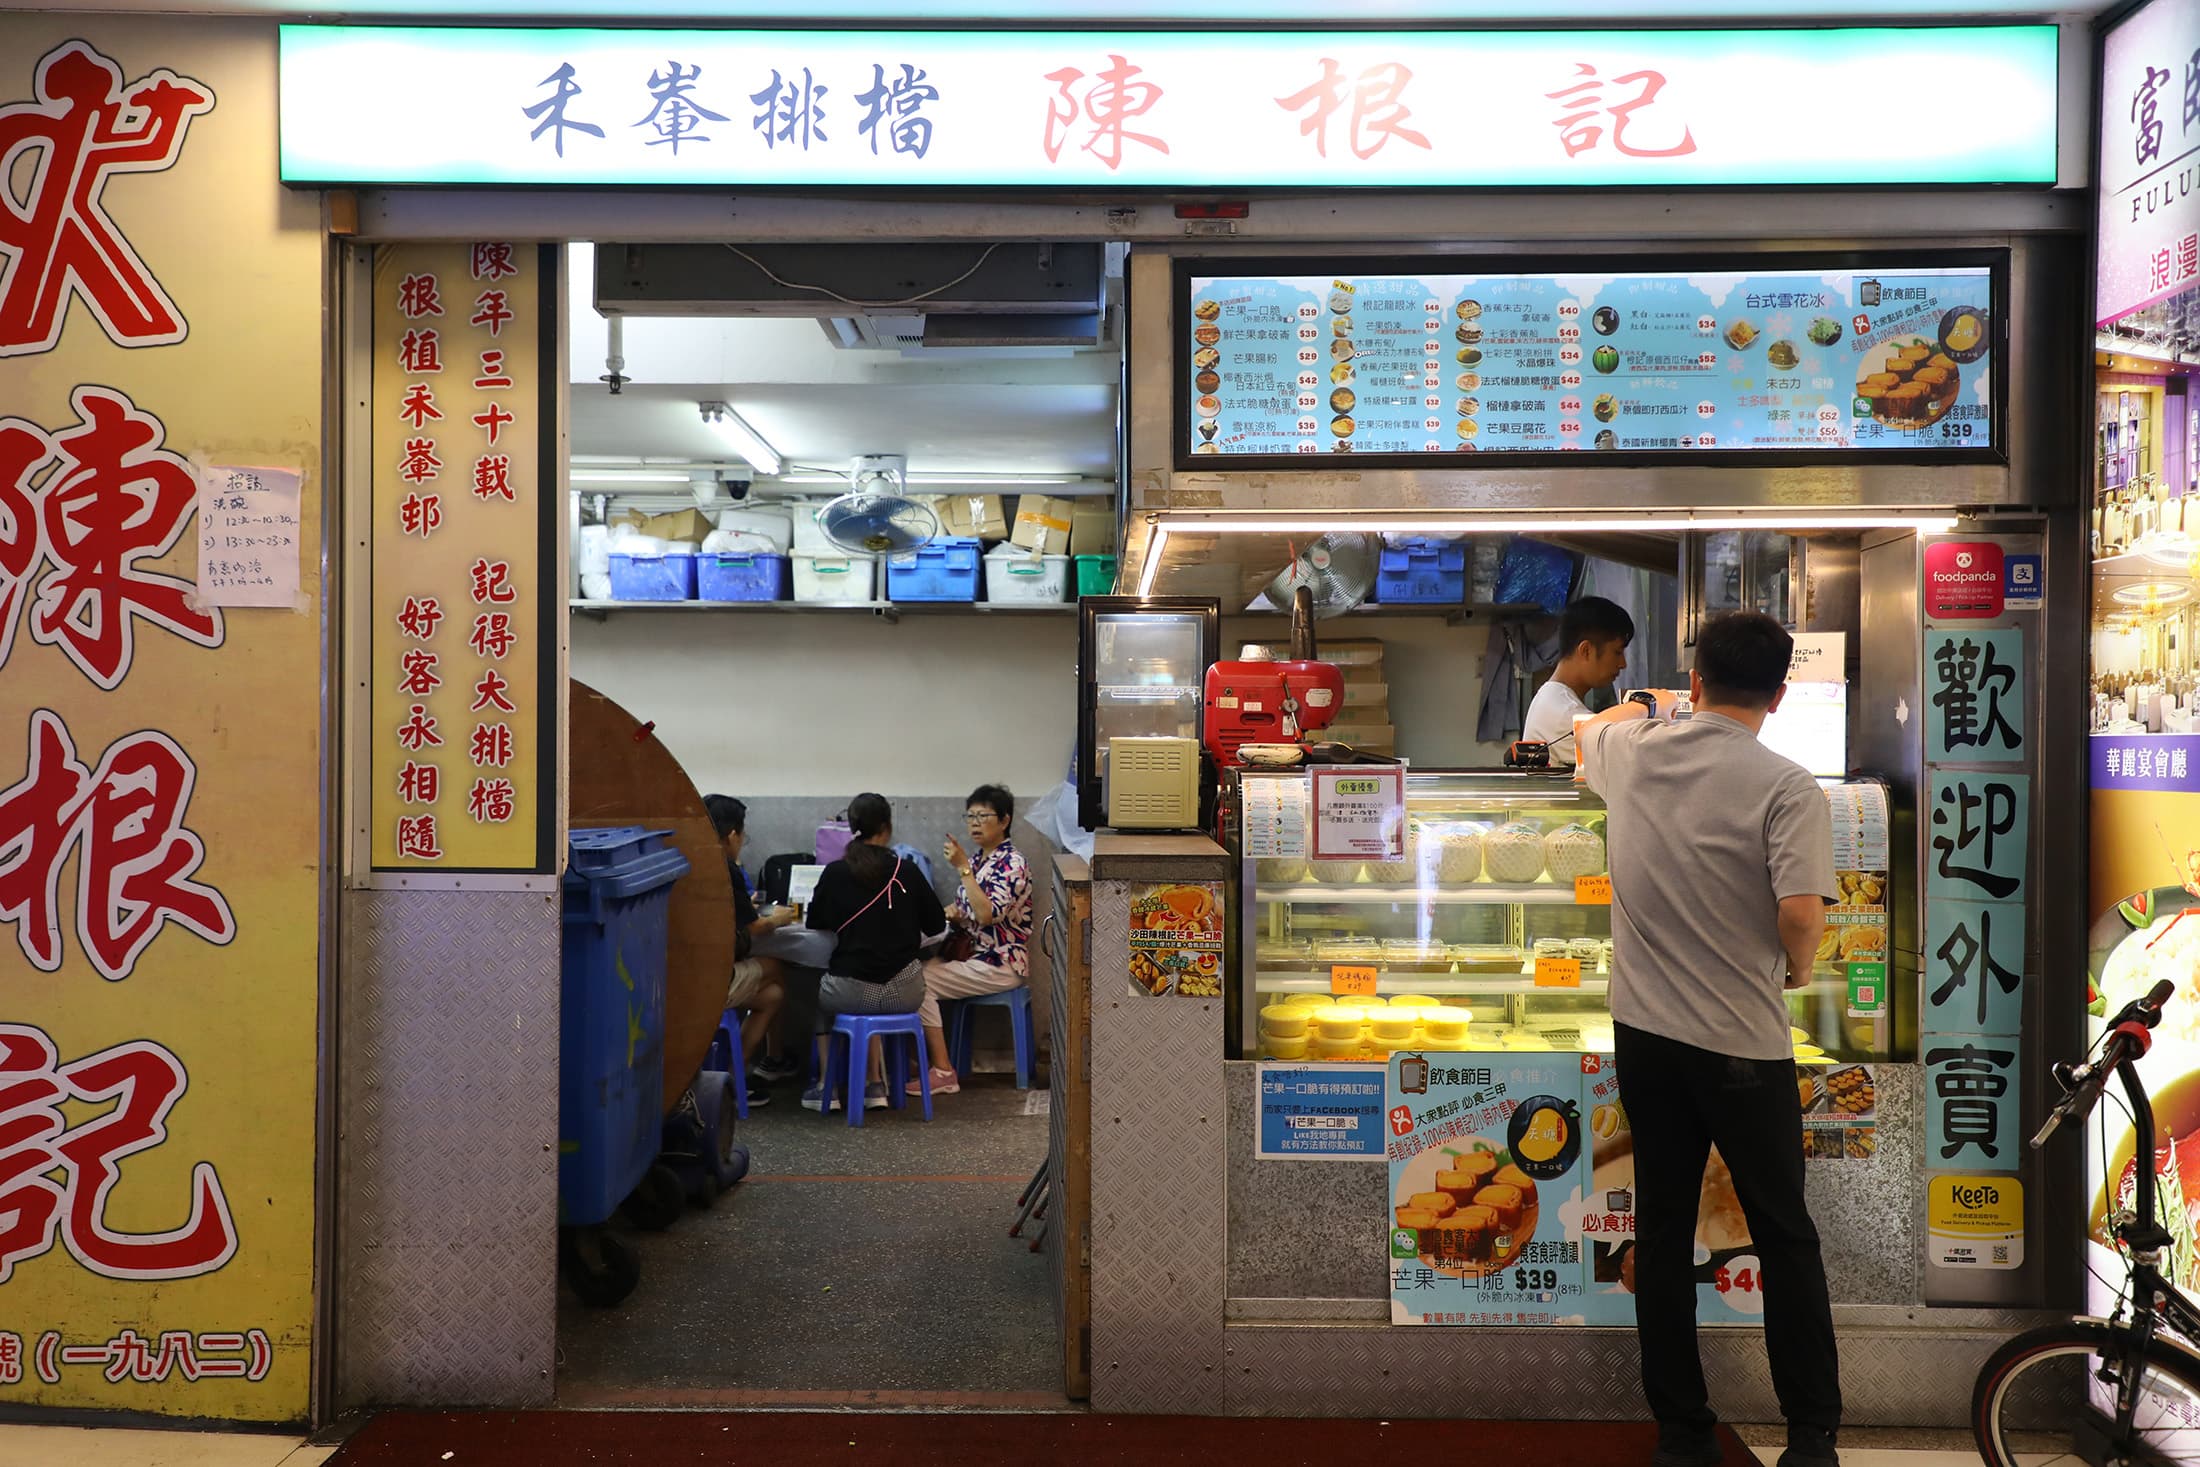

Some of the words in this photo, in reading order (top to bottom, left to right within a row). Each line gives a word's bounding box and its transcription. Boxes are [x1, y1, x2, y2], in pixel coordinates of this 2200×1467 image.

[521, 60, 940, 160] 禾輋排檔
[1043, 54, 1698, 170] 陳根記
[2131, 165, 2200, 223] FULU
[1882, 287, 1927, 300] 飲食節目
[1746, 292, 1825, 309] 台式雪花冰
[1299, 308, 1317, 316] $39
[1559, 307, 1578, 315] $40
[1698, 320, 1717, 328] $34
[1299, 352, 1317, 360] $29
[1560, 351, 1579, 359] $34
[1698, 355, 1717, 363] $52
[469, 242, 516, 504] 陳年三十載
[1299, 376, 1317, 384] $42
[1560, 376, 1580, 384] $42
[1560, 401, 1580, 409] $44
[1819, 411, 1838, 420] $52
[1487, 423, 1546, 434] 芒果豆腐花
[1819, 427, 1838, 436] $56
[1852, 423, 1935, 439] 芒果一口脆
[1942, 423, 1973, 438] $39
[1932, 571, 1996, 584] foodpanda
[469, 558, 516, 824] 記得大排檔
[397, 596, 443, 861] 好客永相隨
[2106, 747, 2188, 779] 華麗宴會廳
[1925, 637, 2023, 1159] 歡迎外賣
[1430, 1067, 1492, 1086] 飲食節目
[1462, 1082, 1508, 1110] 必食三甲
[1296, 1117, 1347, 1128] 芒果一口脆
[1391, 1268, 1505, 1291] 芒果一口脆
[1514, 1267, 1558, 1291] $39
[1713, 1265, 1763, 1293] $4
[1469, 1312, 1513, 1325] 先到先得
[1516, 1312, 1561, 1325] 售完即止
